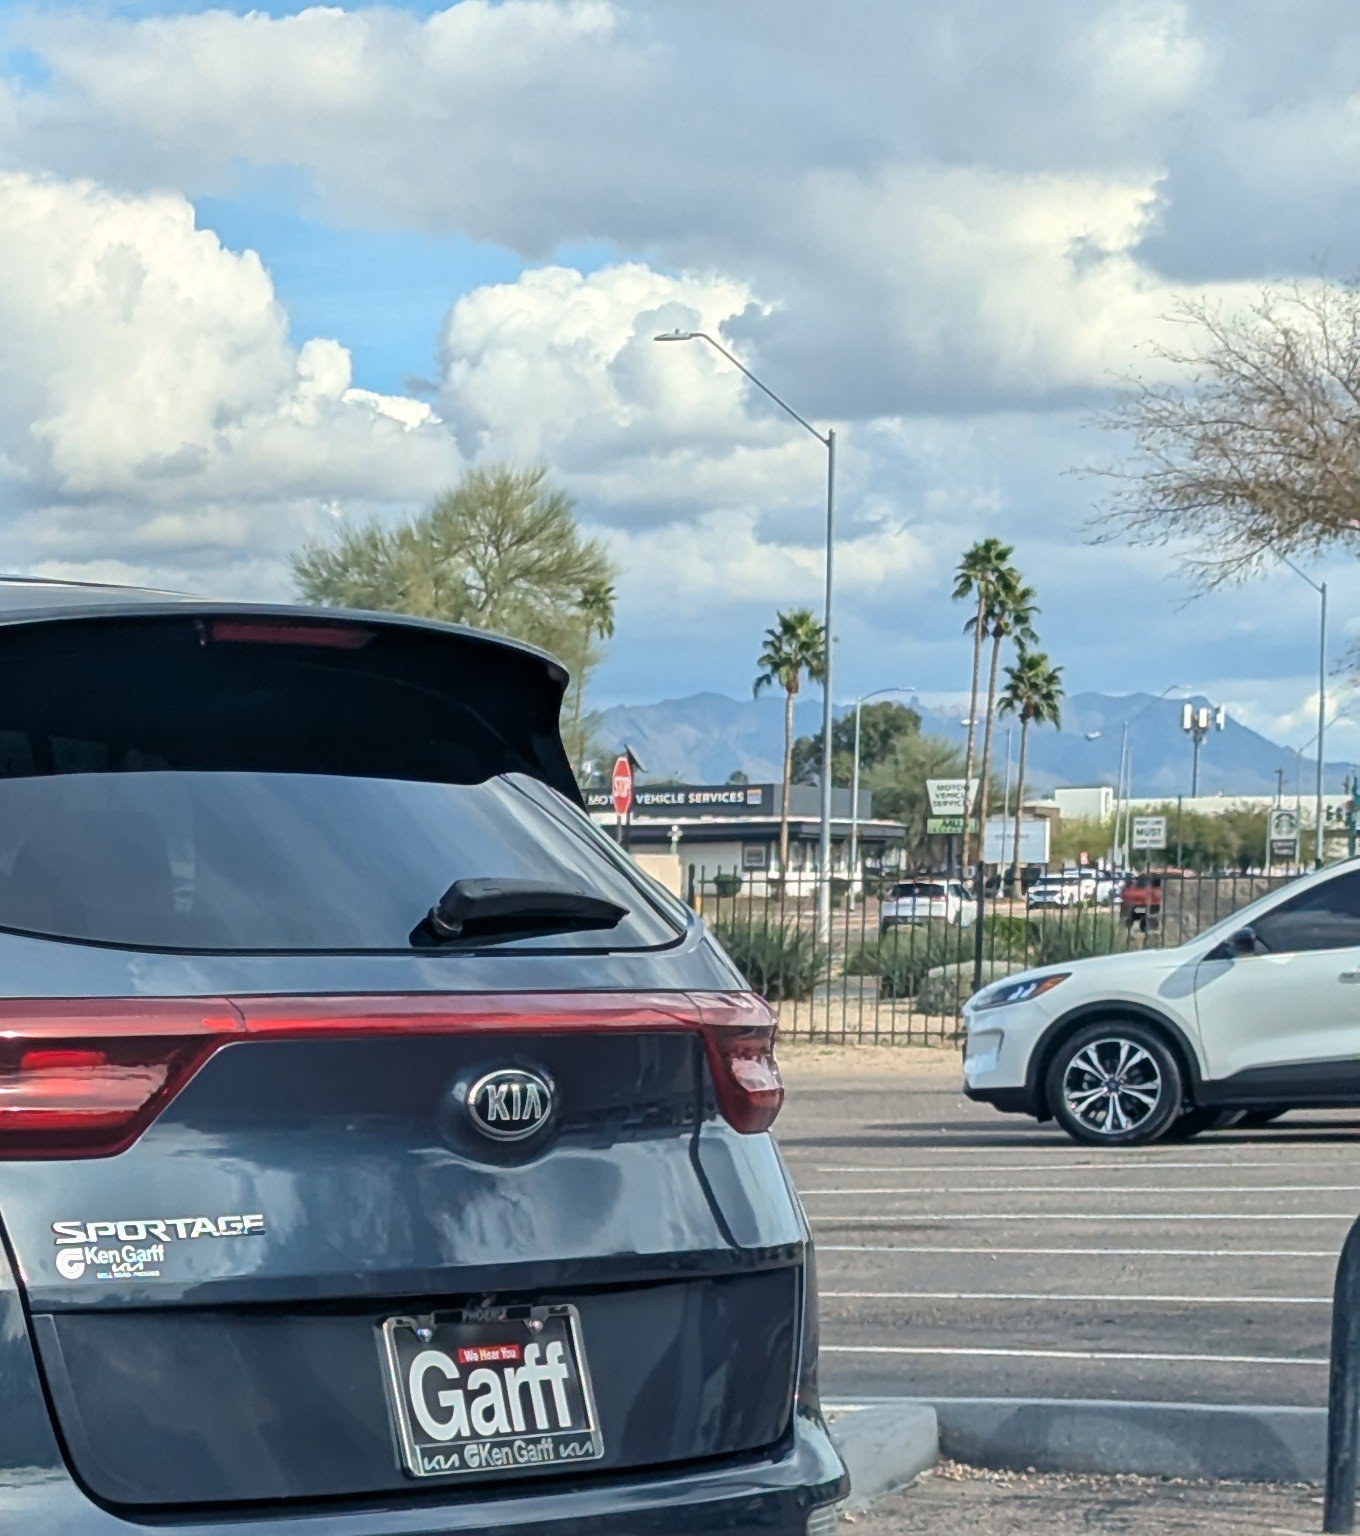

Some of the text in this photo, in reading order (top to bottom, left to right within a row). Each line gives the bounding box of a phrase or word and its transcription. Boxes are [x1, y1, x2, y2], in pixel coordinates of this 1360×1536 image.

[635, 794, 685, 804] VEHICLE
[688, 791, 744, 803] SERVICES
[486, 1083, 542, 1121] KIA
[52, 1213, 266, 1246] SPORTAGE
[85, 1247, 120, 1265] Ken
[122, 1244, 165, 1262] Garff
[409, 1341, 572, 1441] Garff
[479, 1443, 513, 1466] Ken
[513, 1438, 554, 1464] Garff
